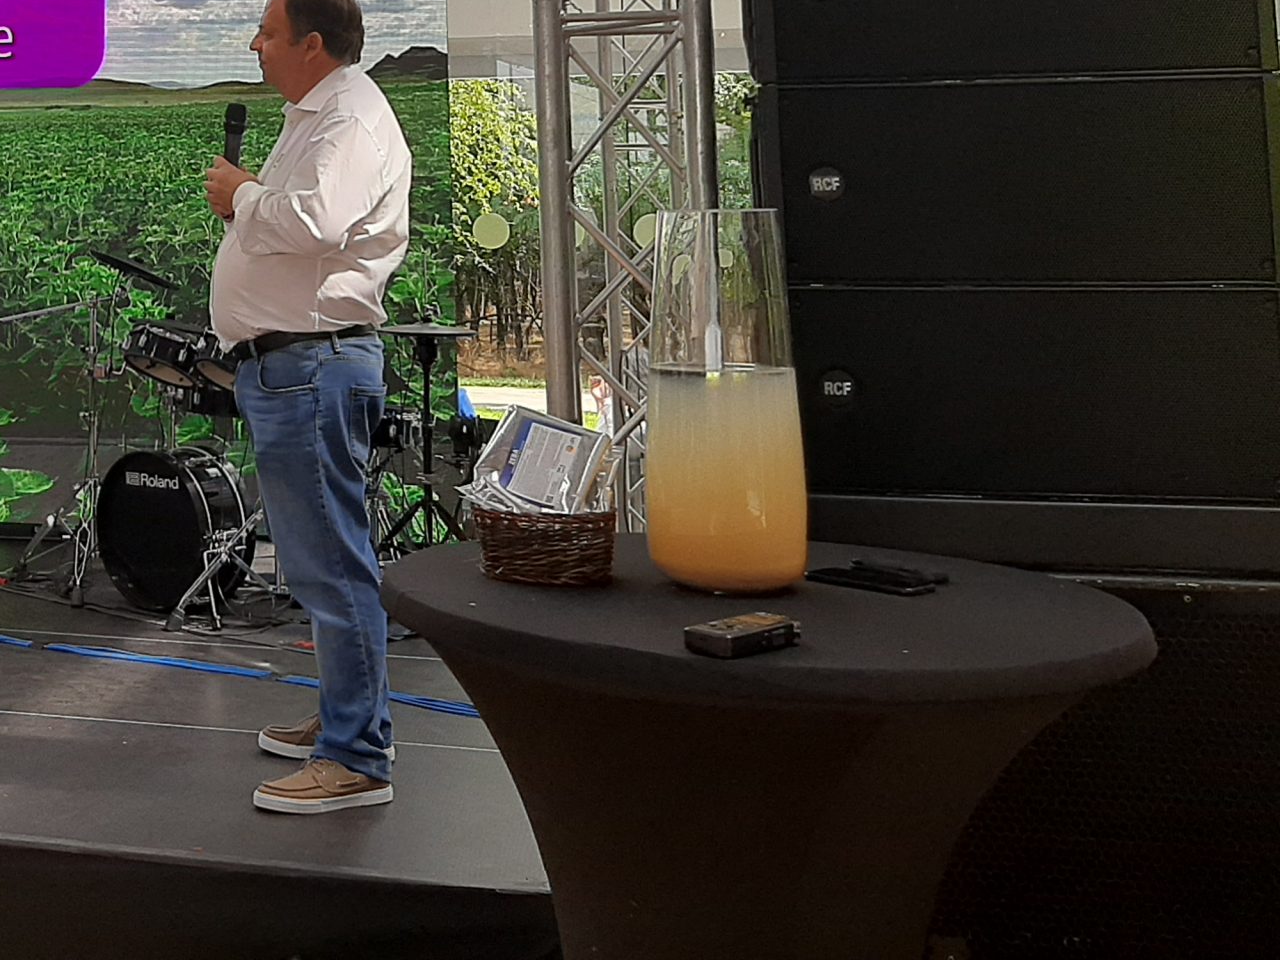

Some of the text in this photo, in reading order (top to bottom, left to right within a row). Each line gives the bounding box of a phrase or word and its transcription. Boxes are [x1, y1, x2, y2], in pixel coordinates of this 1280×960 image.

[812, 177, 840, 191] RCF
[824, 381, 852, 396] RCF
[141, 473, 179, 489] Roland
